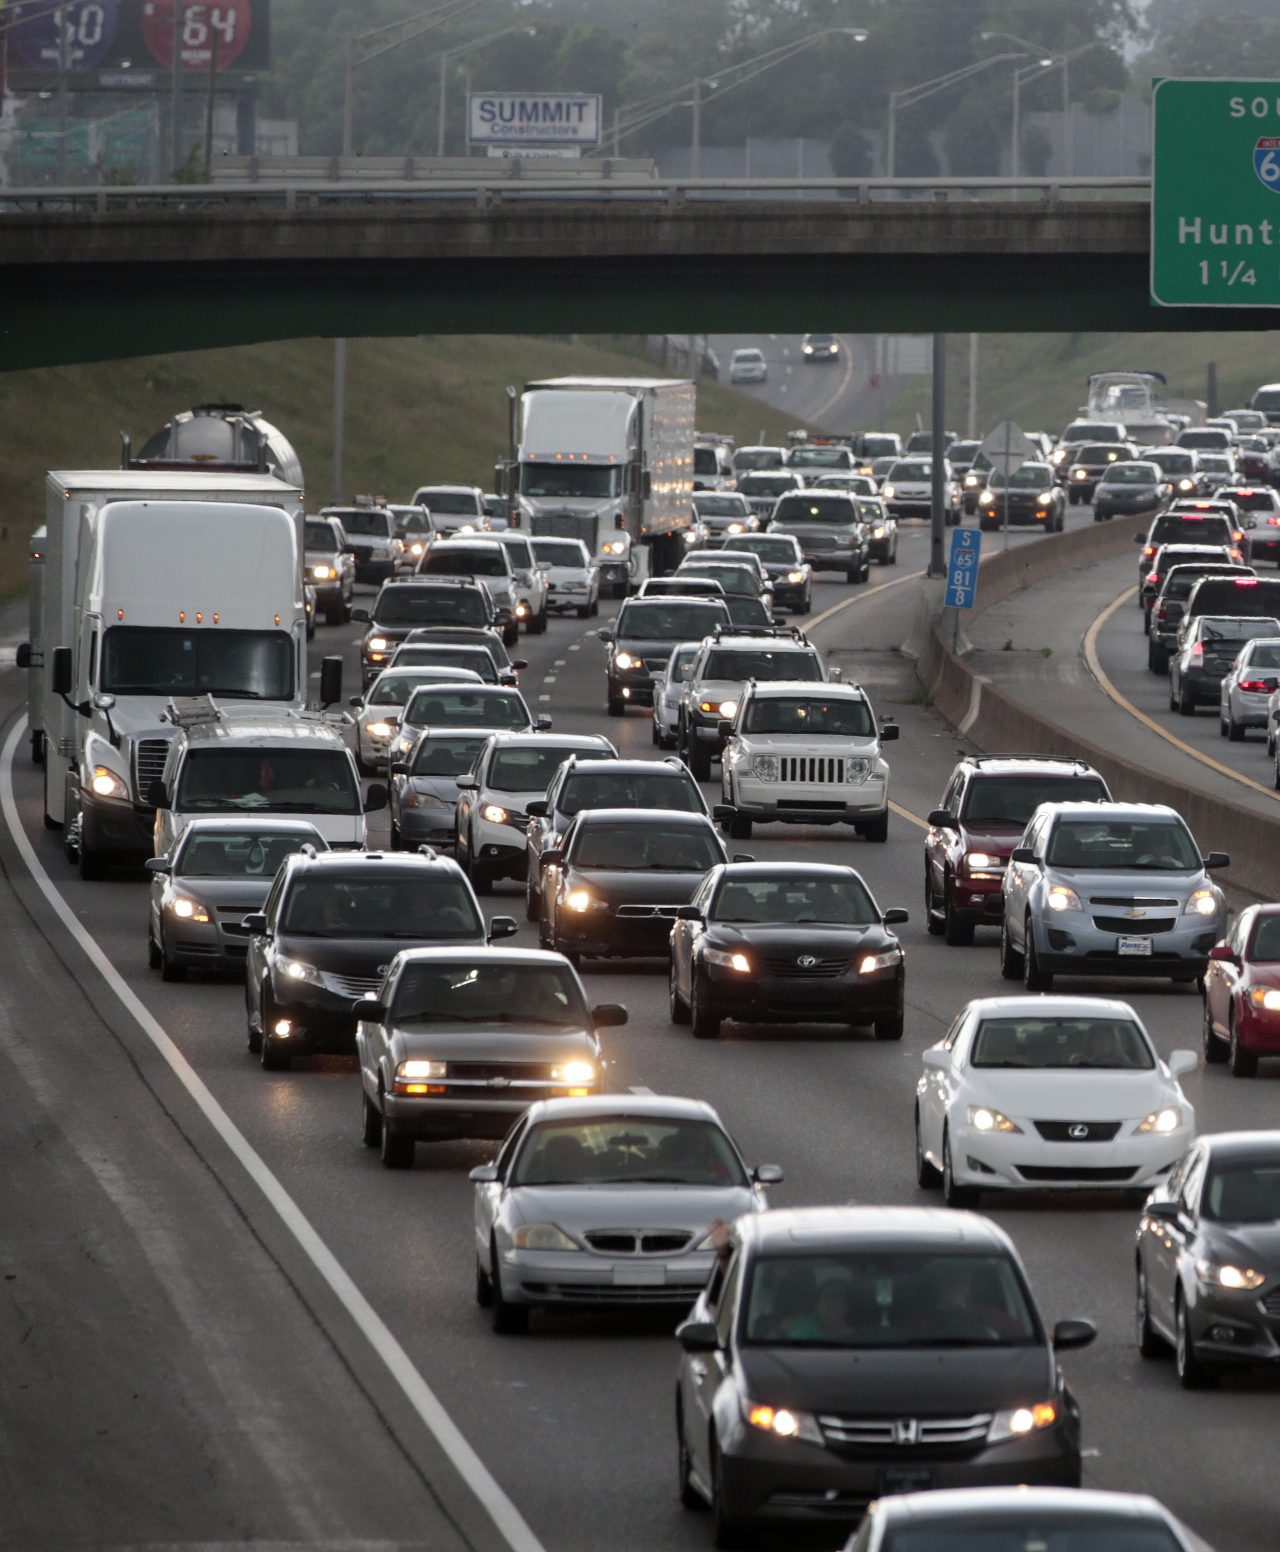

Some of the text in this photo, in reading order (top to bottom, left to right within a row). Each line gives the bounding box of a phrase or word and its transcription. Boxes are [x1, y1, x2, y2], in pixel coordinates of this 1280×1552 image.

[479, 100, 589, 122] SUMMIT
[491, 123, 578, 135] Constructors
[962, 532, 971, 545] S
[957, 555, 972, 566] 65
[954, 570, 969, 586] 81
[955, 591, 964, 605] 8
